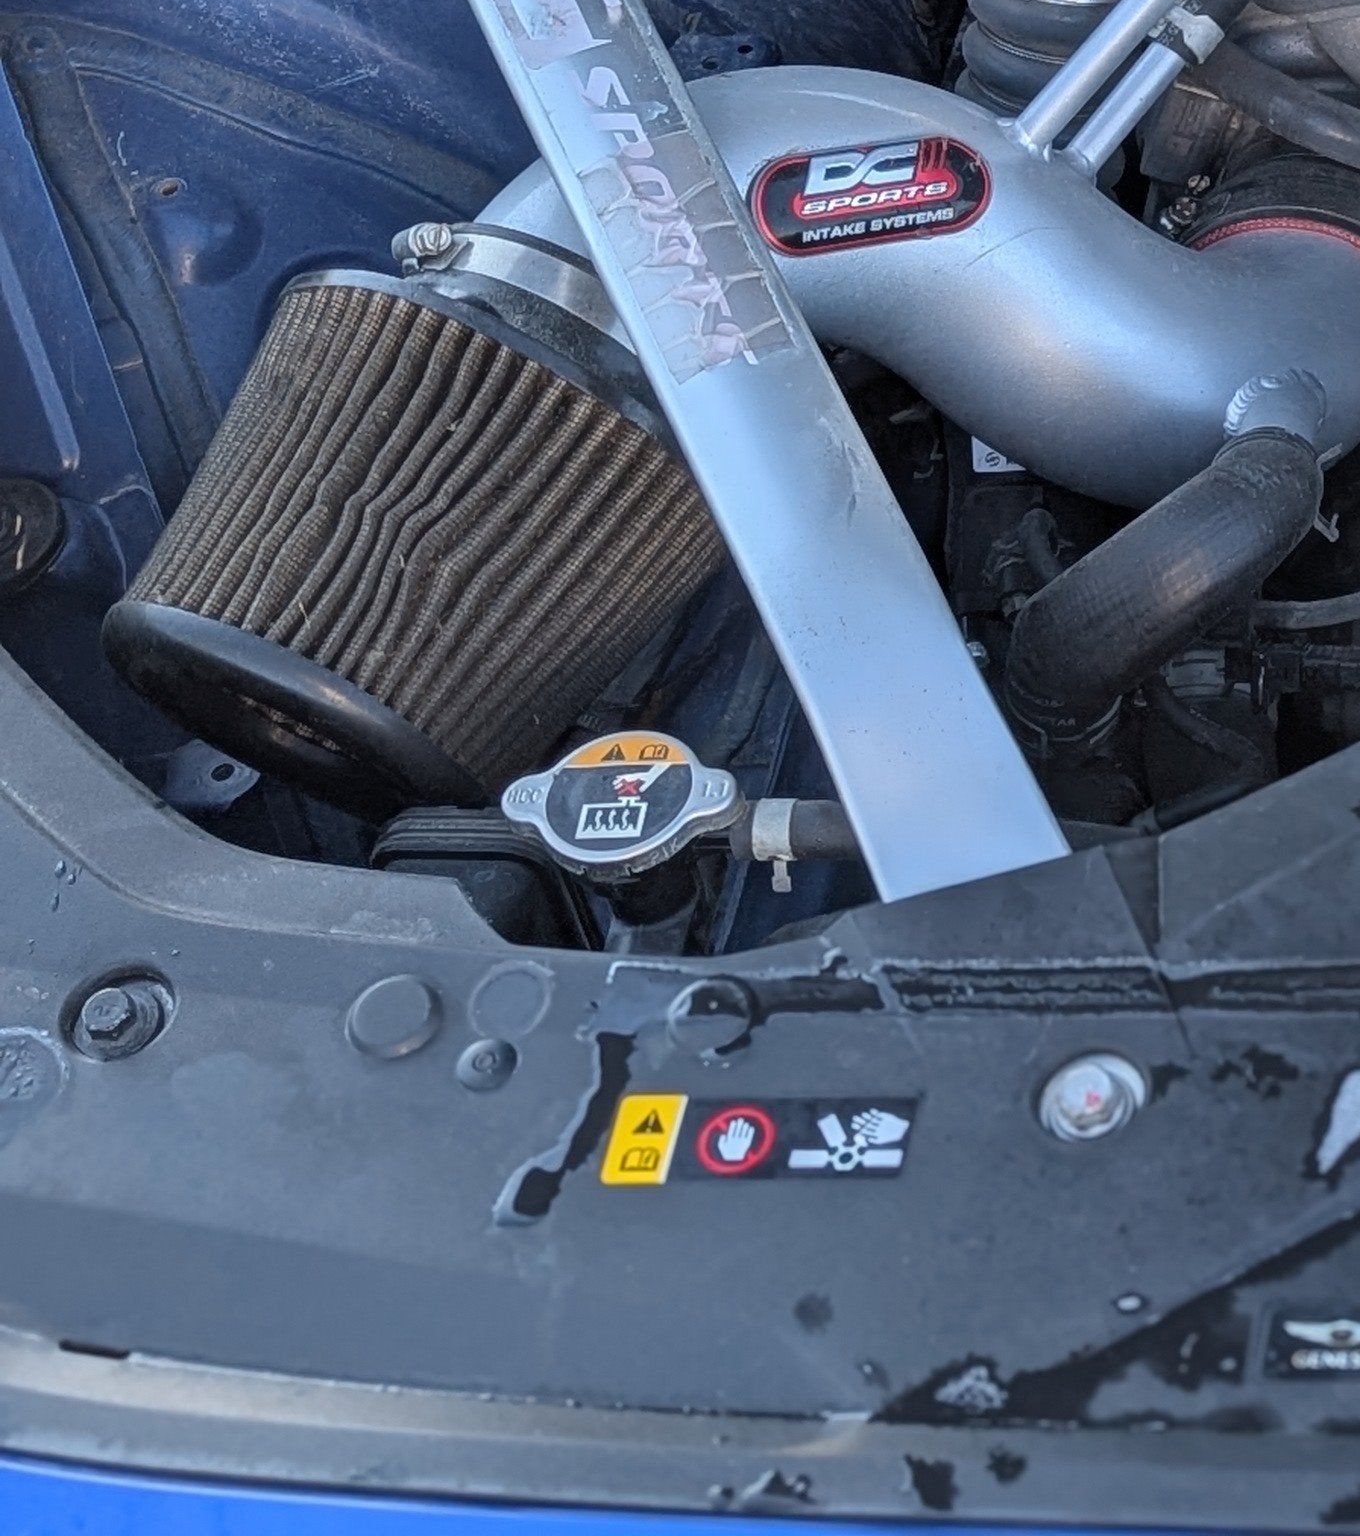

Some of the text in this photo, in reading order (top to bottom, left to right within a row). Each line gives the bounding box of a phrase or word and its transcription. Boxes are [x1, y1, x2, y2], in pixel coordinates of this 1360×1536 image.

[804, 140, 919, 196] DC
[801, 181, 948, 215] SPORTS
[802, 207, 955, 244] INTAKE SYSTEMS
